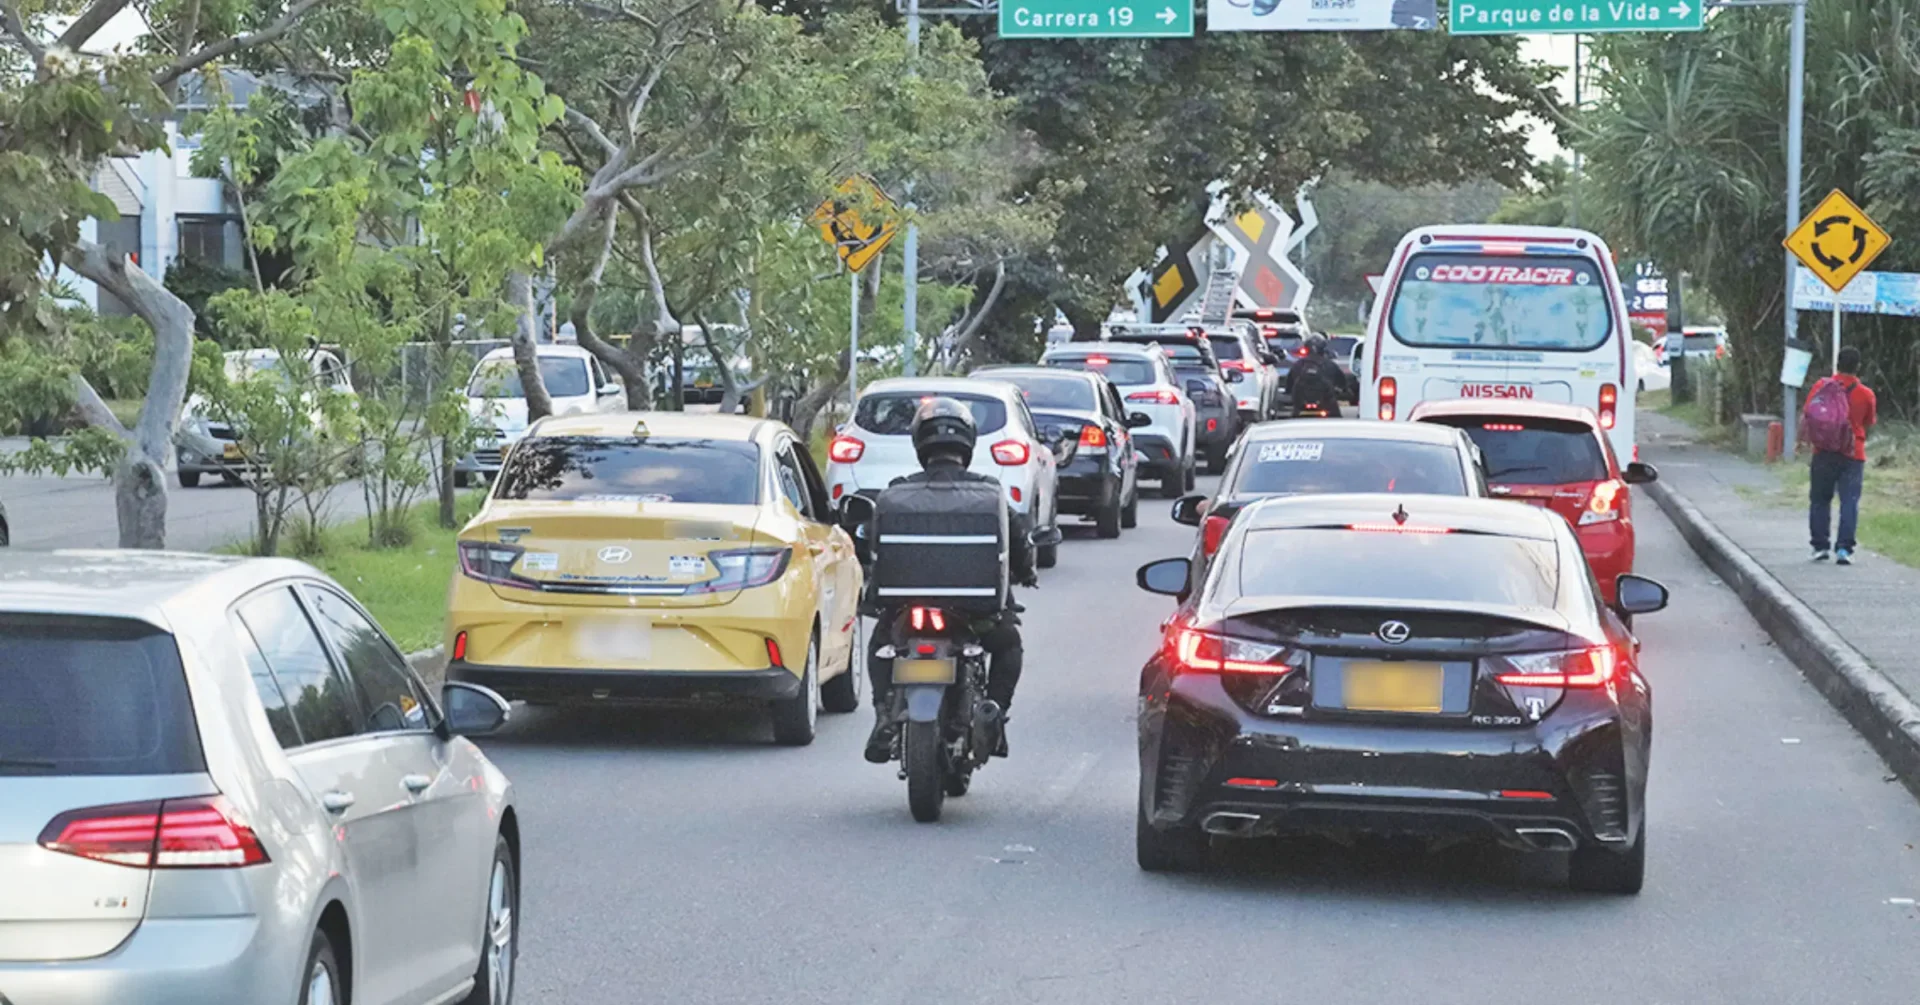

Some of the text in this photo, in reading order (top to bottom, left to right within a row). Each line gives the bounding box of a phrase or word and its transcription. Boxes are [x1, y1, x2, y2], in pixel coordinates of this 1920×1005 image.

[1013, 6, 1134, 27] Carrera 19
[1458, 1, 1661, 27] Parque de la Vida
[1460, 383, 1534, 400] NISSAN
[1472, 715, 1492, 724] RC
